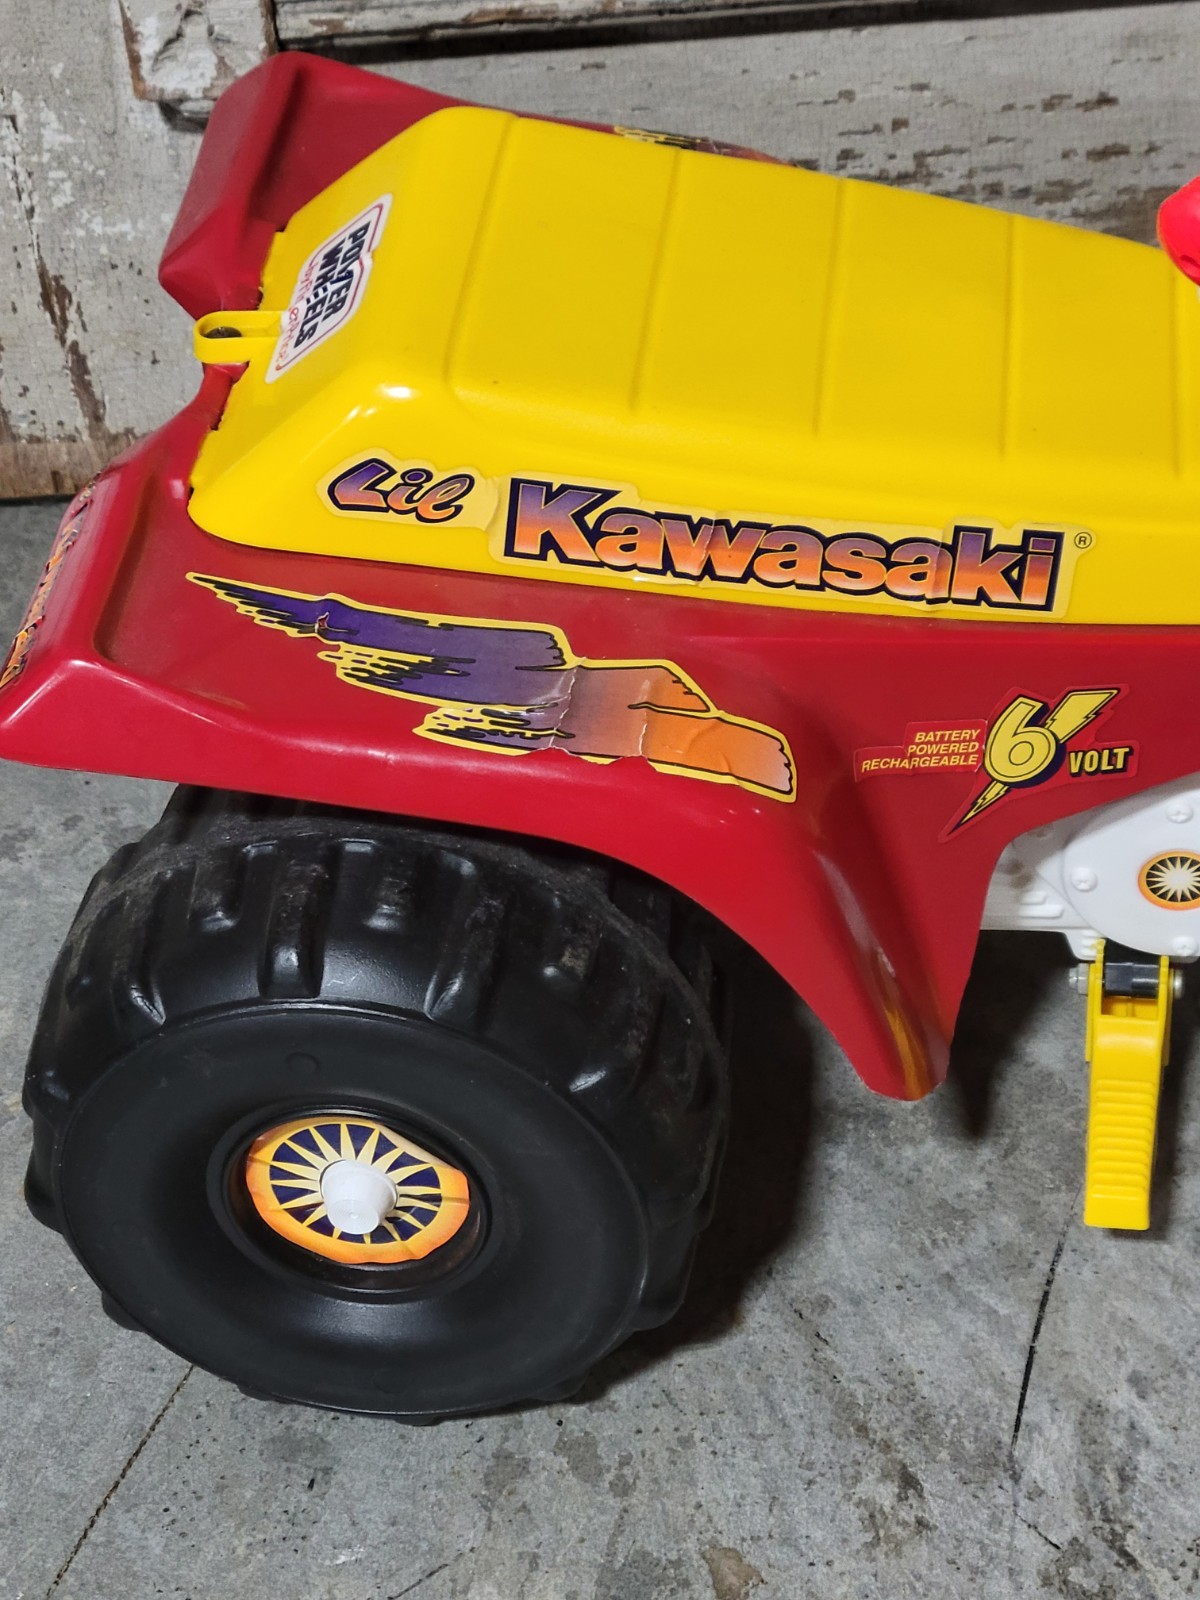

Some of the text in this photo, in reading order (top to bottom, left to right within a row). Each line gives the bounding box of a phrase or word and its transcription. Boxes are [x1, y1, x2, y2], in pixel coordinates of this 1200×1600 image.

[293, 237, 346, 349] WHEELS
[321, 220, 371, 322] POWER
[327, 457, 475, 524] Lil
[503, 477, 1065, 612] Kawasaki
[861, 754, 979, 773] RECHARGEABLE
[908, 742, 979, 756] POWERED
[915, 729, 980, 743] BATTERY
[984, 694, 1060, 785] 6
[1069, 747, 1131, 776] VOLT
